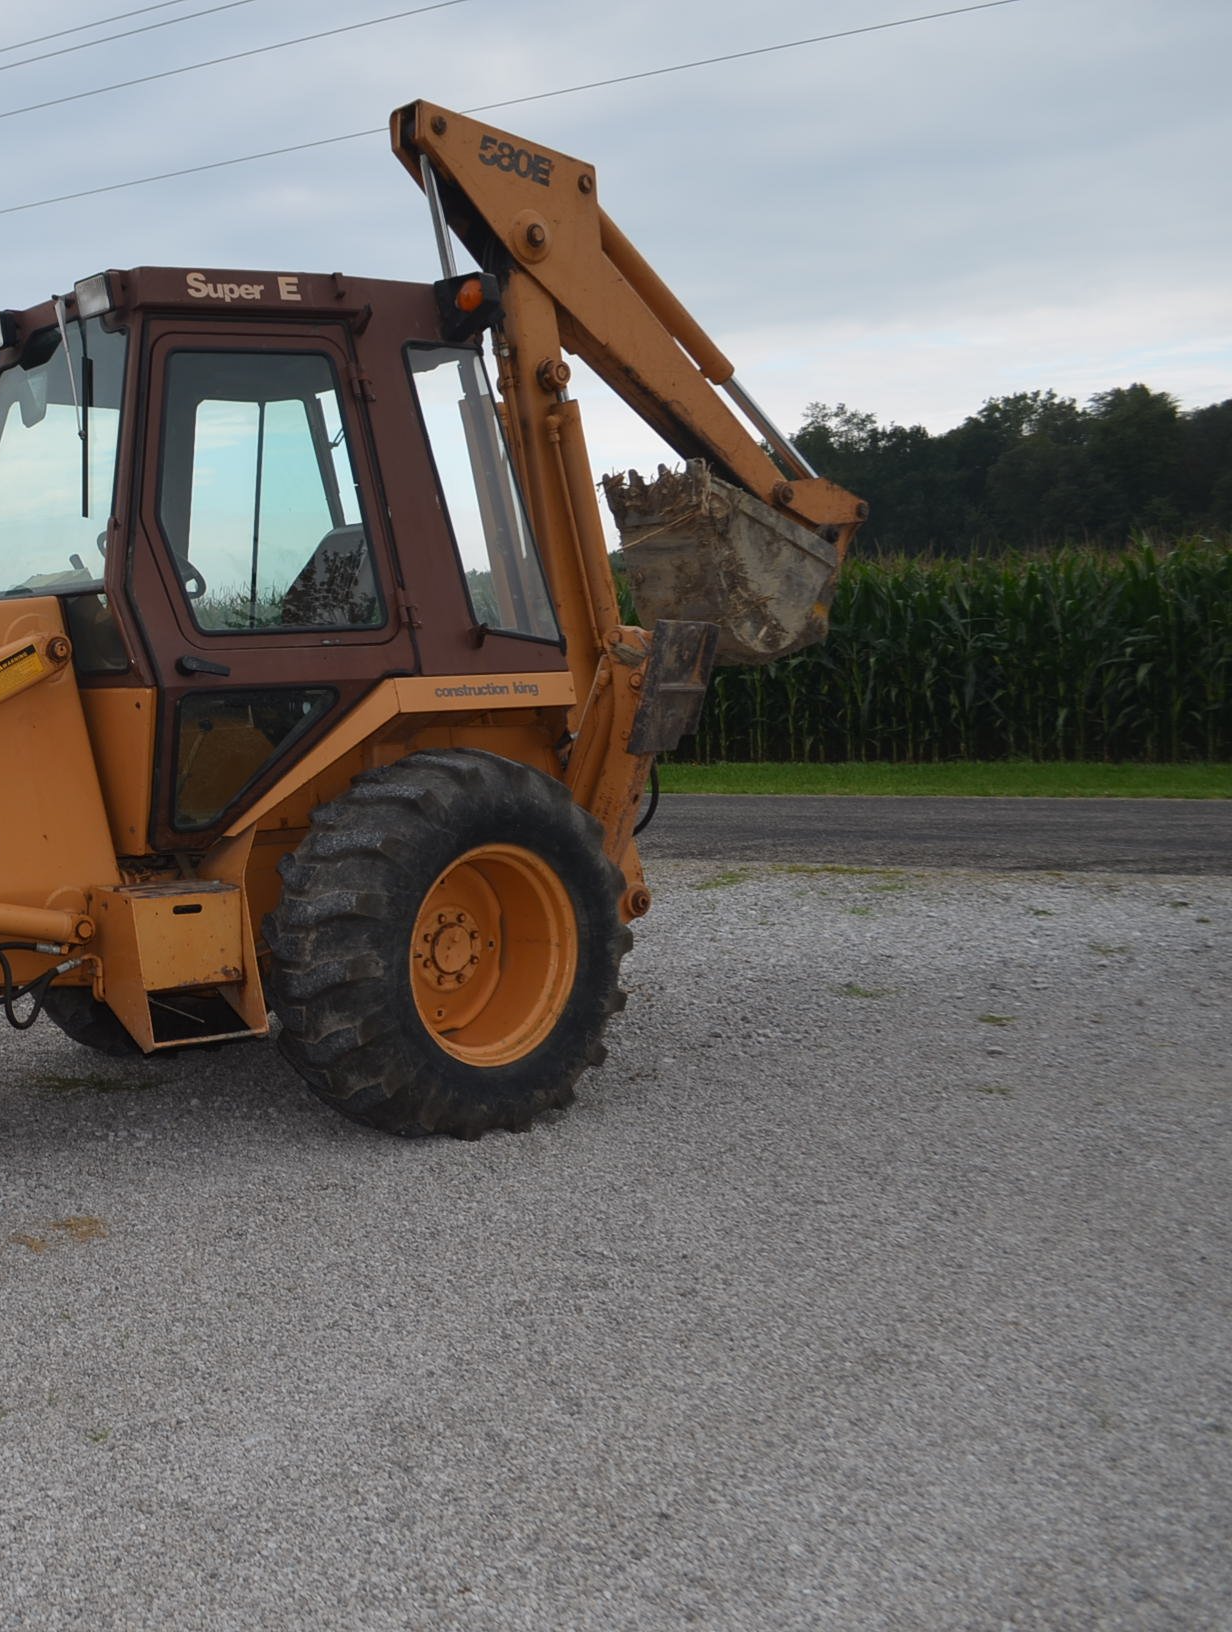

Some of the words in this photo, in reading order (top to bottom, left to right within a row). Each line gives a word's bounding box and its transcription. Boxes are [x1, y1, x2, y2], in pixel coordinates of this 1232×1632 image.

[478, 134, 552, 188] 580E
[186, 272, 265, 303] Super
[277, 276, 302, 301] E
[434, 682, 509, 697] construction
[512, 681, 539, 697] king
